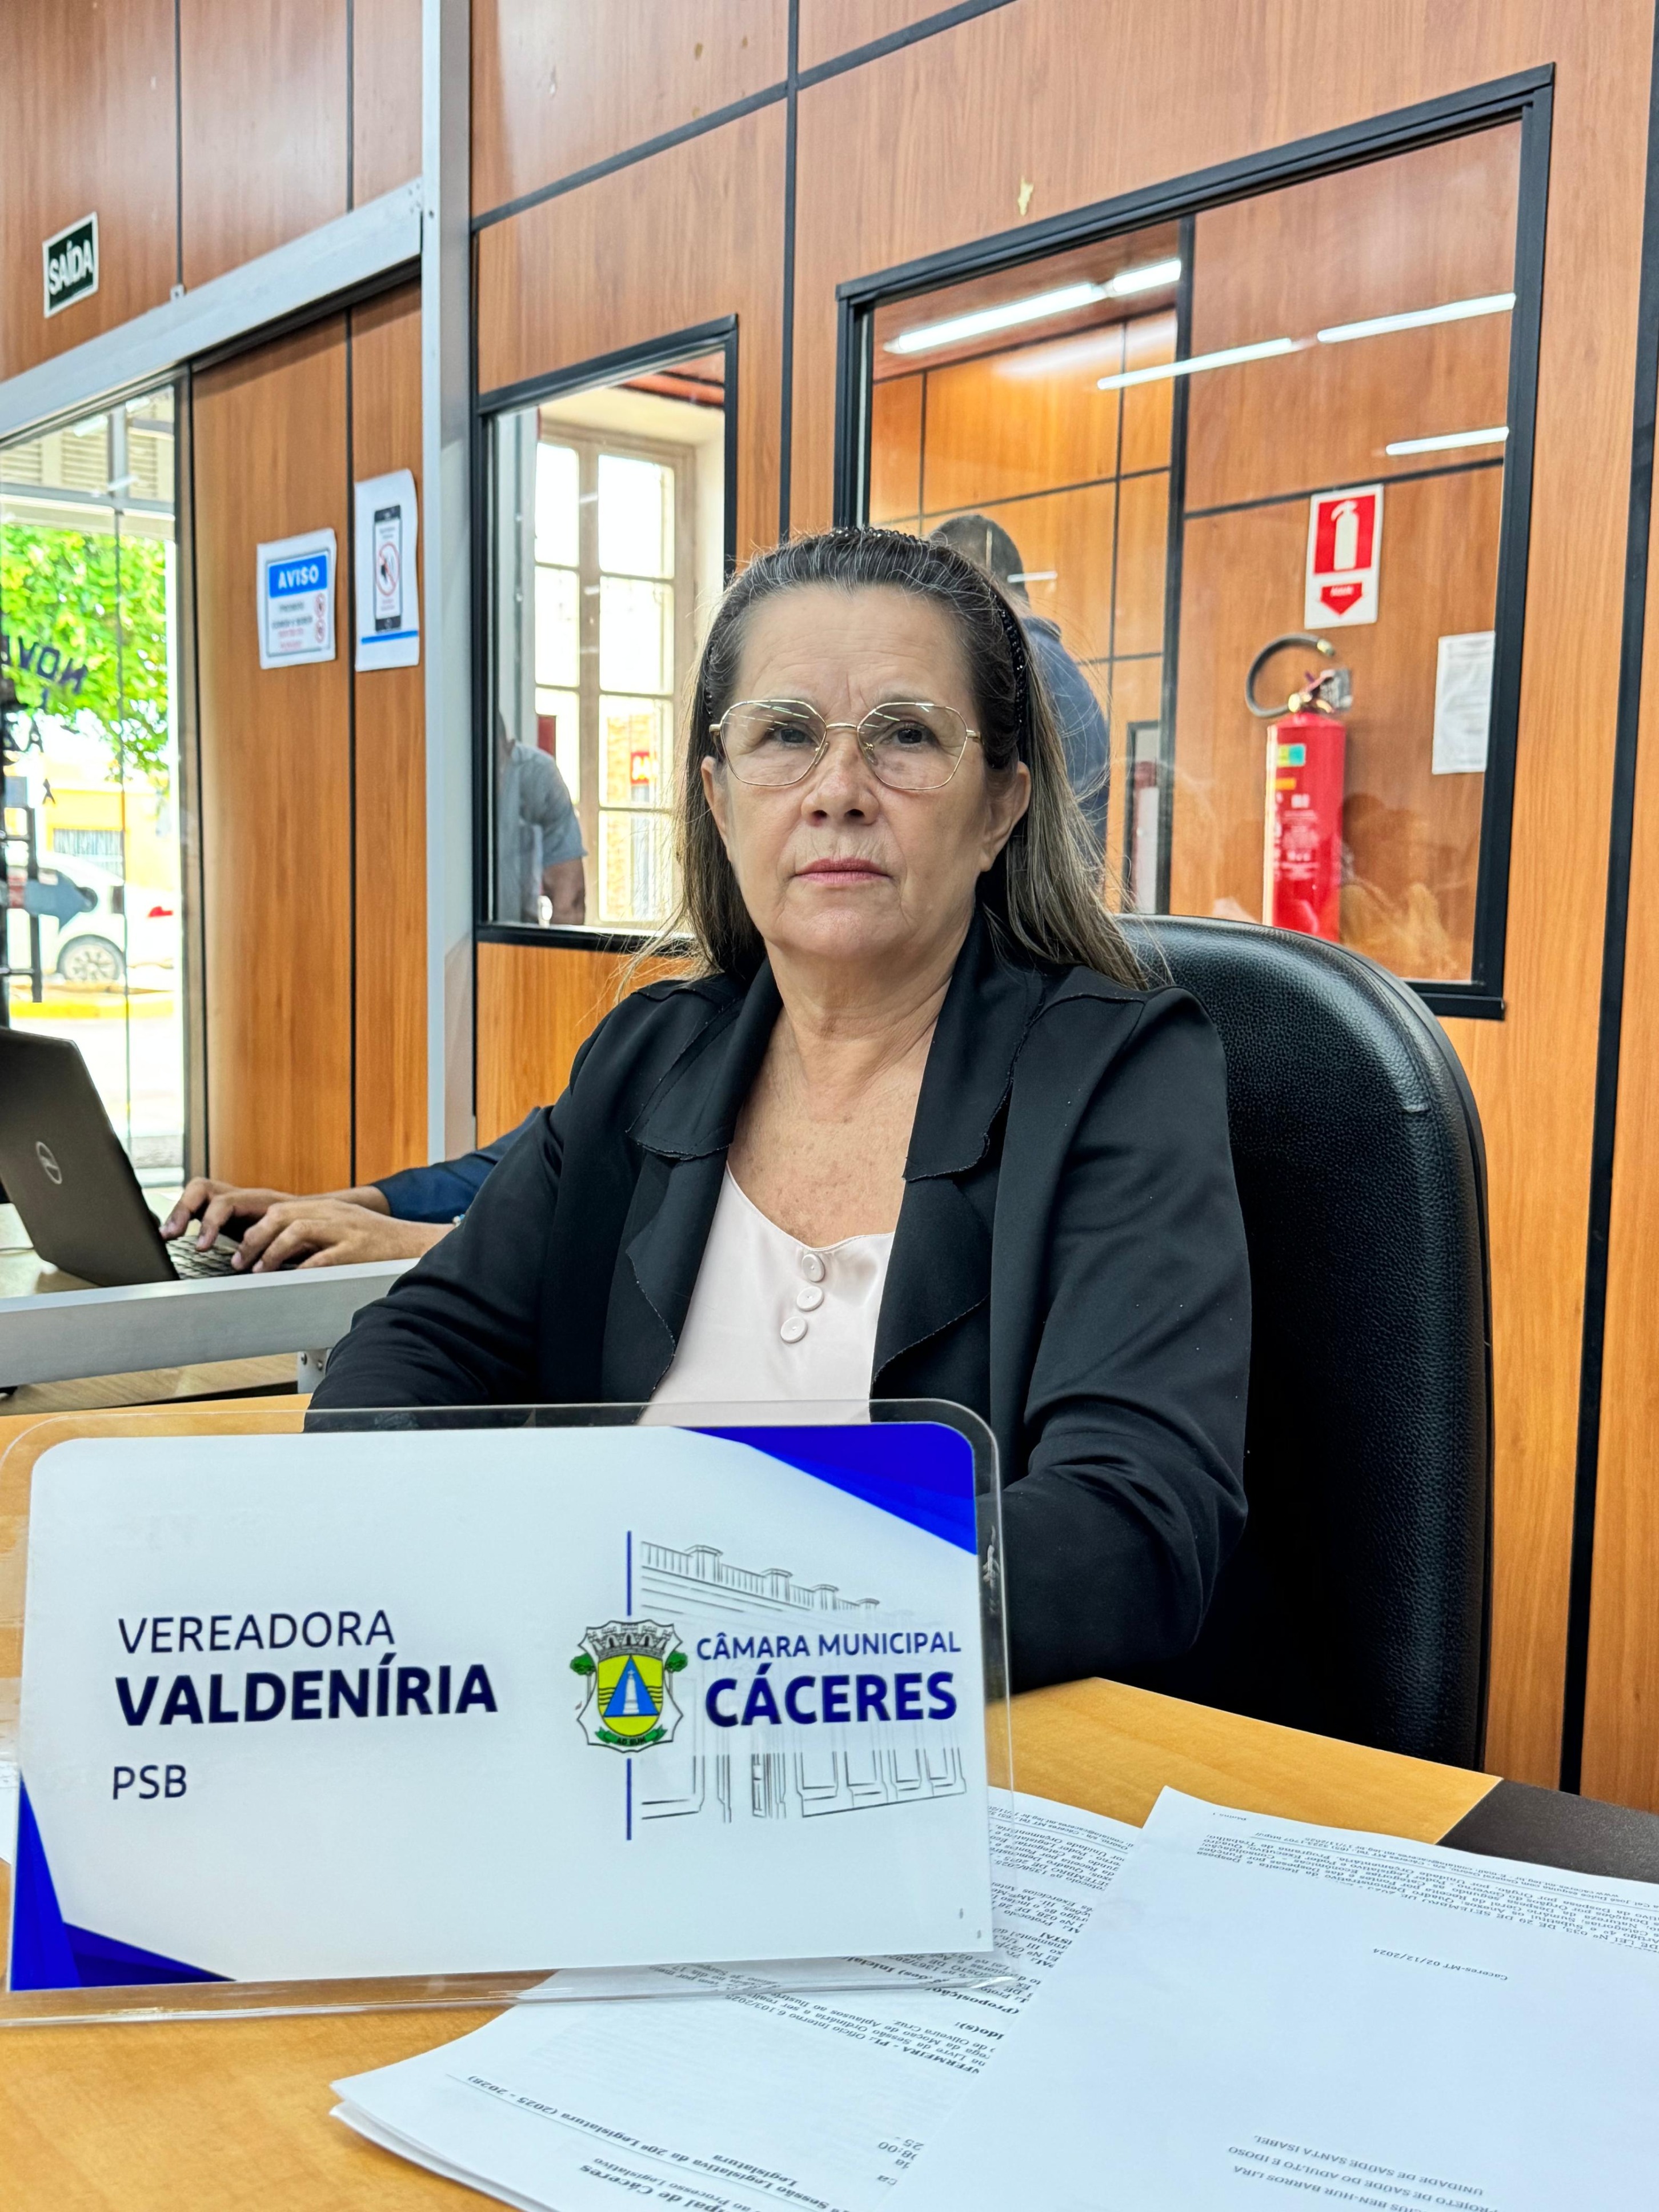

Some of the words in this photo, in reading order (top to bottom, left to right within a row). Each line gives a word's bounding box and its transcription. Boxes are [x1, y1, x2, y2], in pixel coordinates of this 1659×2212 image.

[49, 239, 94, 296] SAÍDA
[278, 564, 320, 590] AVISO
[118, 1609, 395, 1654] VEREADORA
[696, 1631, 810, 1661] CÂMARA
[818, 1630, 961, 1656] MUNICIPAL
[115, 1652, 498, 1726] VALDENÍRIA
[704, 1668, 958, 1728] CÁCERES
[112, 1764, 189, 1801] PSB
[1196, 1850, 1241, 1862] Despesa
[1198, 1846, 1243, 1858] Funções
[1278, 1846, 1331, 1860] Programa
[1259, 1862, 1299, 1873] Receita
[1269, 1858, 1320, 1873] Despesas
[1293, 1858, 1359, 1875] Econômicas
[1304, 1856, 1336, 1865] Poder
[1349, 1864, 1410, 1878] Legislativo
[1365, 1870, 1425, 1886] Categorias
[1418, 1871, 1465, 1885] Unidade
[1324, 1874, 1406, 1893] Demonstrativo
[1359, 1875, 1396, 1886] Fontes
[1413, 1875, 1445, 1885] Poder
[1412, 1890, 1454, 1904] Quadro
[1424, 1888, 1466, 1901] Receita
[1451, 1888, 1500, 1901] segundo
[1457, 1884, 1505, 1897] Governo
[1490, 1901, 1522, 1912] Geral
[1506, 1898, 1554, 1913] Despesa
[1562, 1900, 1610, 1913] Despesa
[1526, 1909, 1576, 1925] Sumário
[1584, 1914, 1637, 1929] Natureza
[1538, 1921, 1556, 1930] DE
[1562, 1925, 1588, 1935] 033,
[1373, 1947, 1440, 1966] 02/12/2024
[788, 2013, 830, 2029] Interno
[814, 2012, 868, 2032] Ordinária
[829, 2009, 881, 2027] Aplausos
[872, 2029, 912, 2045] Sessão
[924, 2029, 969, 2045] Oliveira
[935, 2047, 967, 2061] Livre
[516, 2097, 558, 2114] (2025
[560, 2113, 640, 2147] Legislatura
[1254, 2135, 1300, 2153] ISABEL
[670, 2152, 690, 2162] da
[1228, 2146, 1269, 2163] IDOSO
[1271, 2157, 1281, 2166] E
[1303, 2147, 1347, 2165] SANTA
[593, 2158, 667, 2186] Legislativo
[692, 2159, 773, 2189] Legislativa
[712, 2154, 798, 2187] Legislatura
[1234, 2165, 1264, 2178] LIRA
[1283, 2161, 1339, 2179] ADULTO
[1348, 2159, 1394, 2176] SAÚDE
[579, 2165, 654, 2194] Cáceres
[1266, 2174, 1321, 2192] BARROS
[1341, 2175, 1361, 2185] DO
[1396, 2171, 1416, 2181] DE
[668, 2182, 731, 2206] Processo
[1363, 2179, 1410, 2197] SAÚDE
[1418, 2176, 1483, 2196] UNIDADE
[775, 2186, 829, 2209] Sessão
[1324, 2187, 1388, 2209] BEN-HUR
[1412, 2191, 1432, 2202] DE
